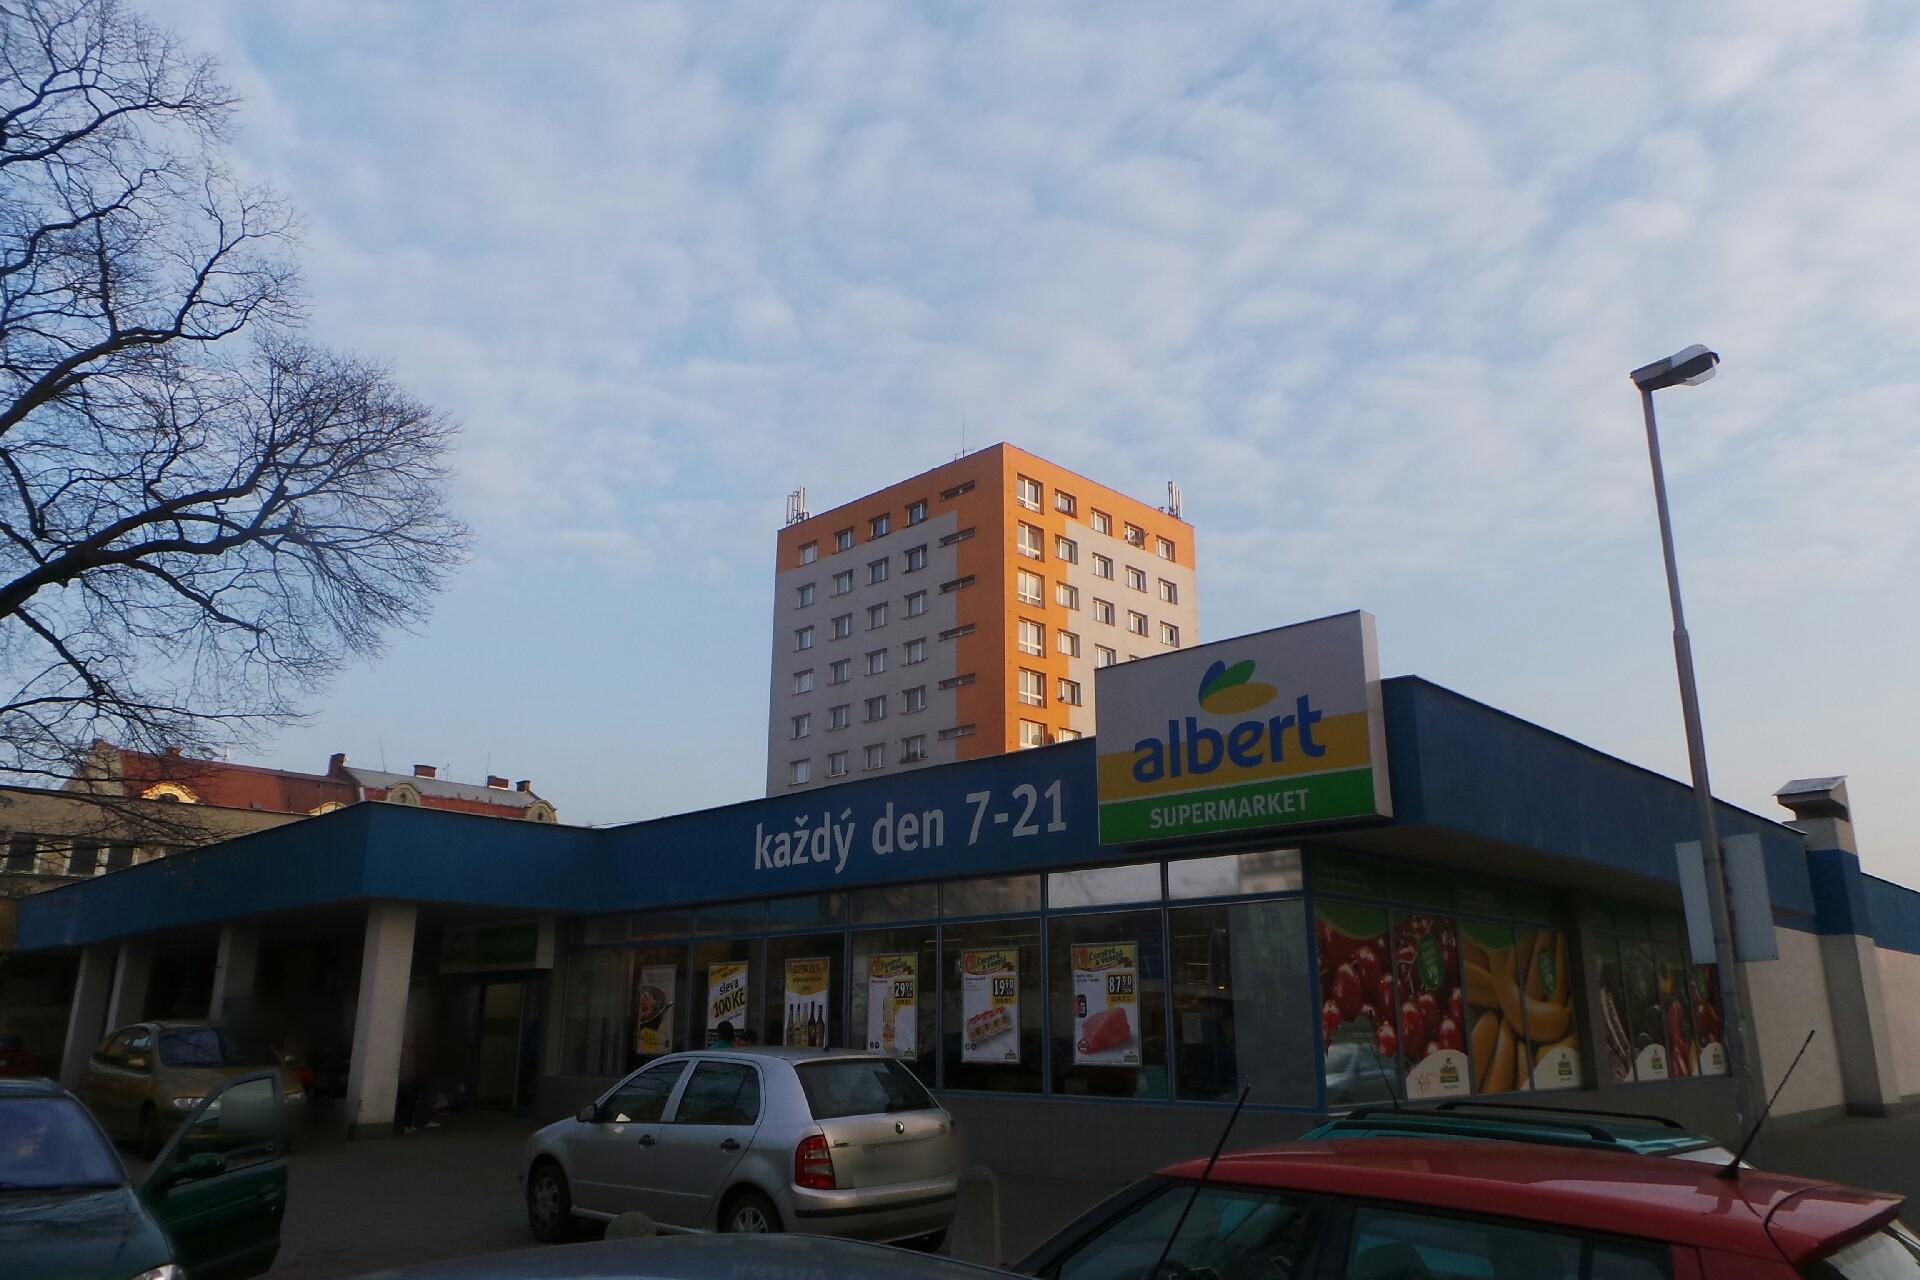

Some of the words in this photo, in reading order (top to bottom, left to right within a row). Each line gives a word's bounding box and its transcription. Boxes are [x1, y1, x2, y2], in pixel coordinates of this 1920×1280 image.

[1132, 694, 1326, 783] albert
[753, 806, 856, 874] každý
[871, 801, 944, 856] den
[965, 779, 1067, 847] 7-21
[1150, 788, 1310, 829] SUPERMARKET
[719, 978, 739, 995] sleva
